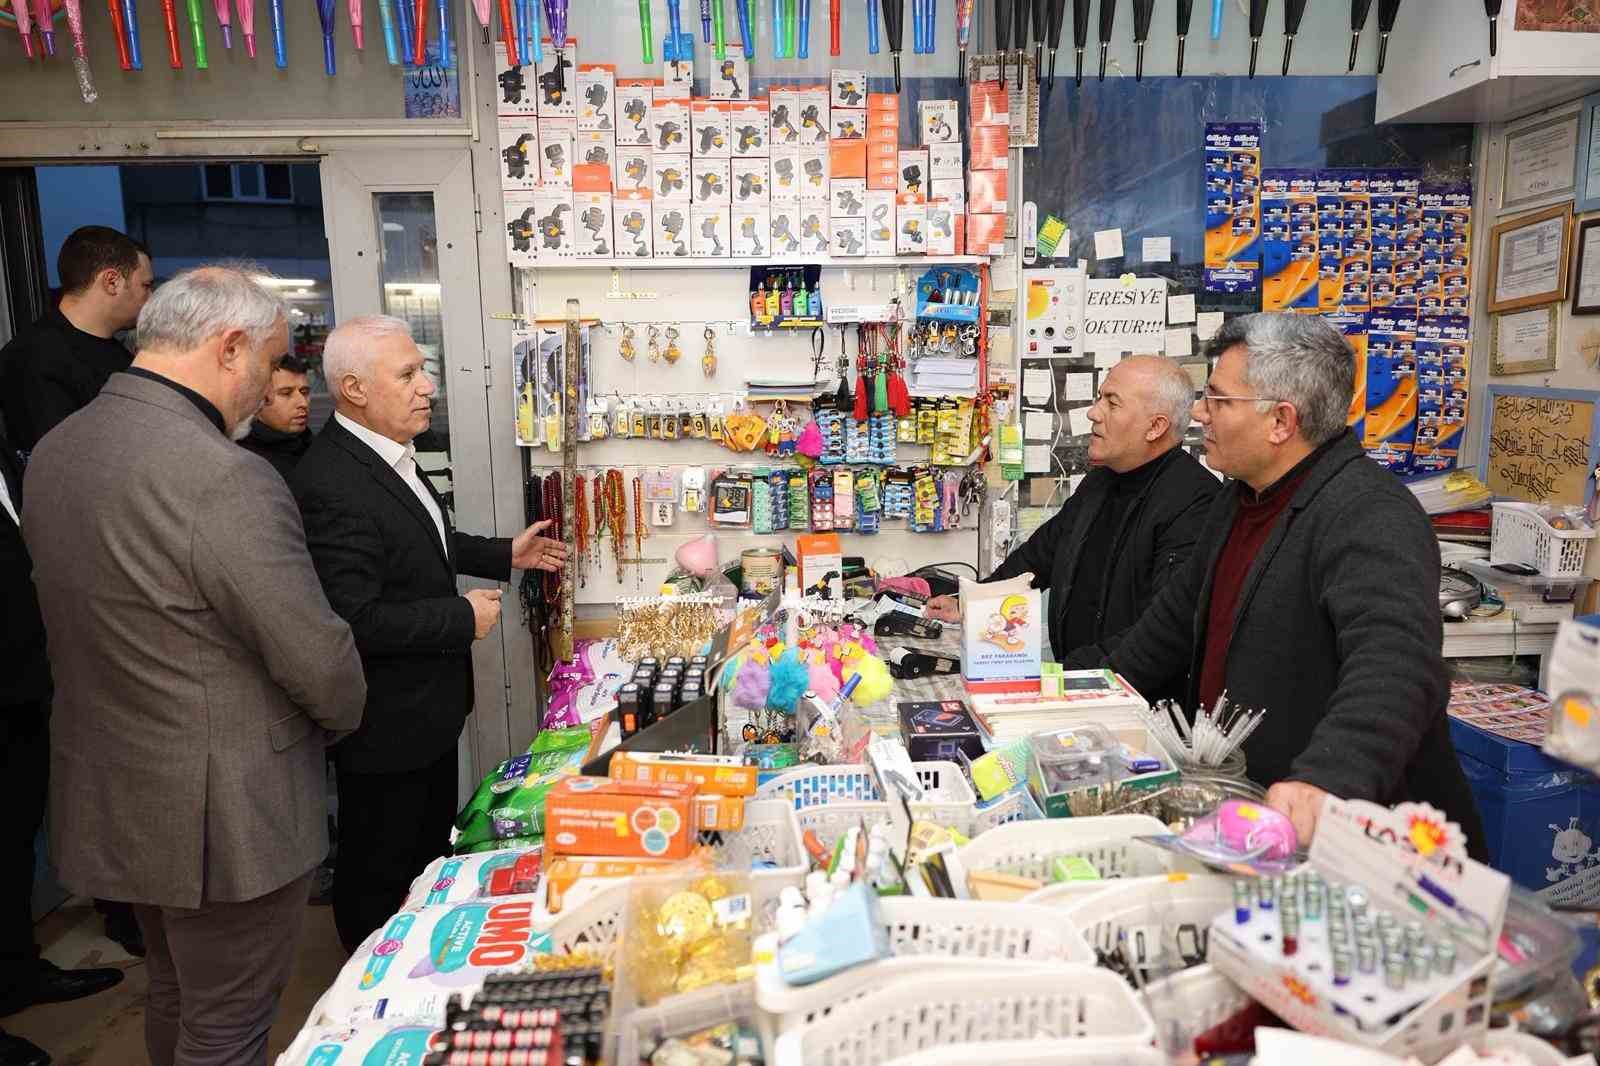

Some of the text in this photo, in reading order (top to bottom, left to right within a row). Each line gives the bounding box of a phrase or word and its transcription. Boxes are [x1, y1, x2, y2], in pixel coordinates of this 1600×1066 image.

[1206, 134, 1232, 142] Gillette
[1233, 134, 1259, 142] Gillette
[1087, 288, 1163, 306] ERESİYE
[652, 421, 660, 431] 4
[667, 421, 674, 433] 6
[695, 420, 703, 432] 9
[711, 423, 719, 432] 4
[450, 920, 473, 953] ACTIVE
[468, 902, 533, 967] UMO
